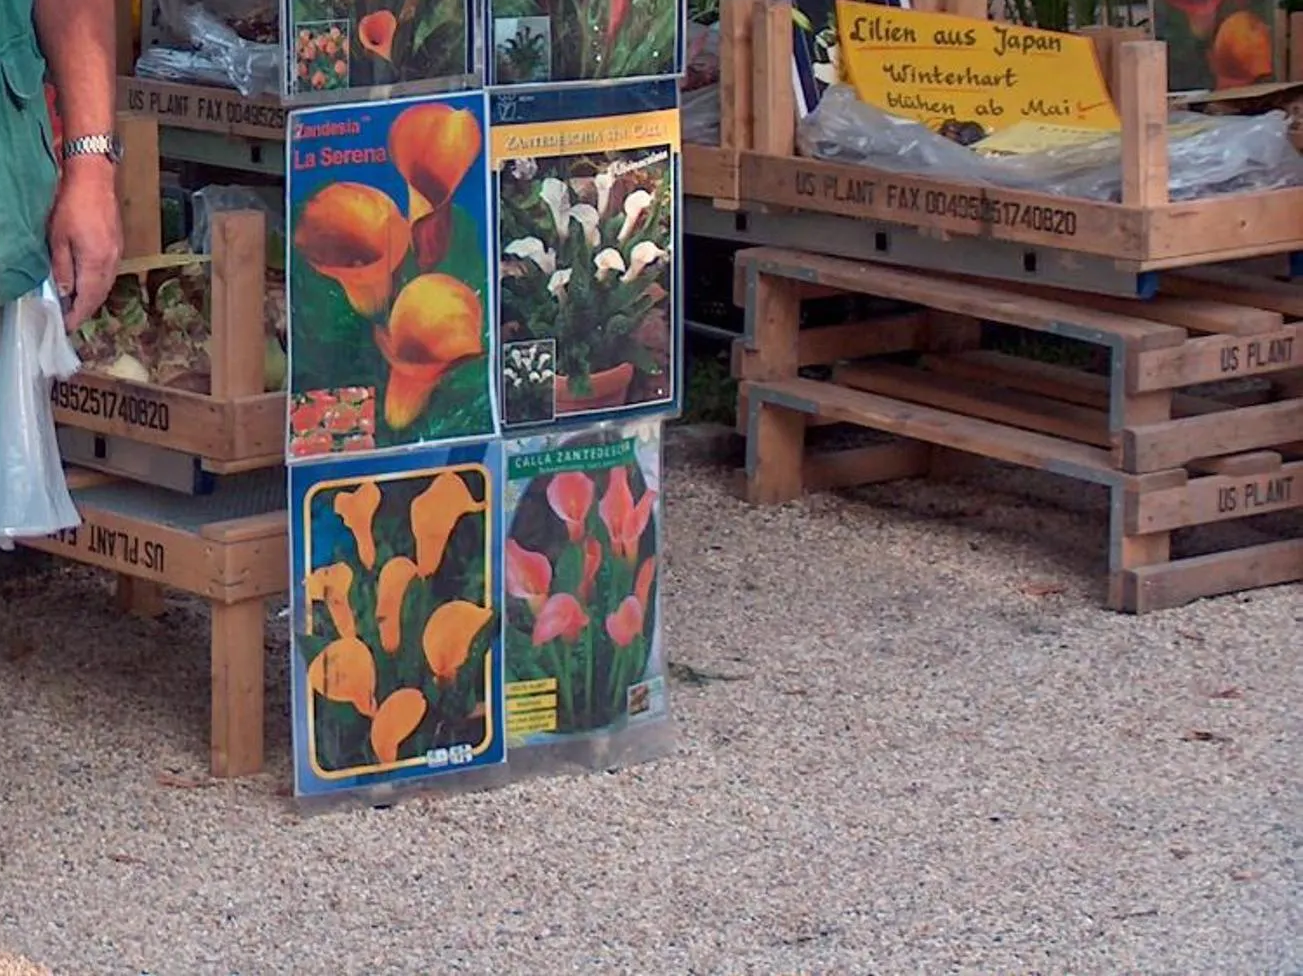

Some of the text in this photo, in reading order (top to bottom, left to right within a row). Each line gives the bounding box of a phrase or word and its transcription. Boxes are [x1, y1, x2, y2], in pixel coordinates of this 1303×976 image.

[850, 16, 1062, 55] Lilien aus Japan
[883, 63, 1018, 87] Winterhart
[128, 88, 145, 110] US
[150, 92, 189, 117] PLANT
[198, 98, 223, 122] FAX
[887, 91, 955, 116] blühen
[975, 98, 1004, 116] ab
[294, 146, 386, 170] La Serena
[796, 171, 815, 197] US
[823, 175, 877, 206] PLANT
[887, 184, 921, 211] FAX
[1220, 336, 1293, 372] US PLANT
[51, 377, 169, 432] 495251740820
[516, 453, 552, 468] CALLA
[1218, 476, 1294, 513] US PLANT
[88, 524, 139, 565] PLANT
[145, 540, 164, 573] US
